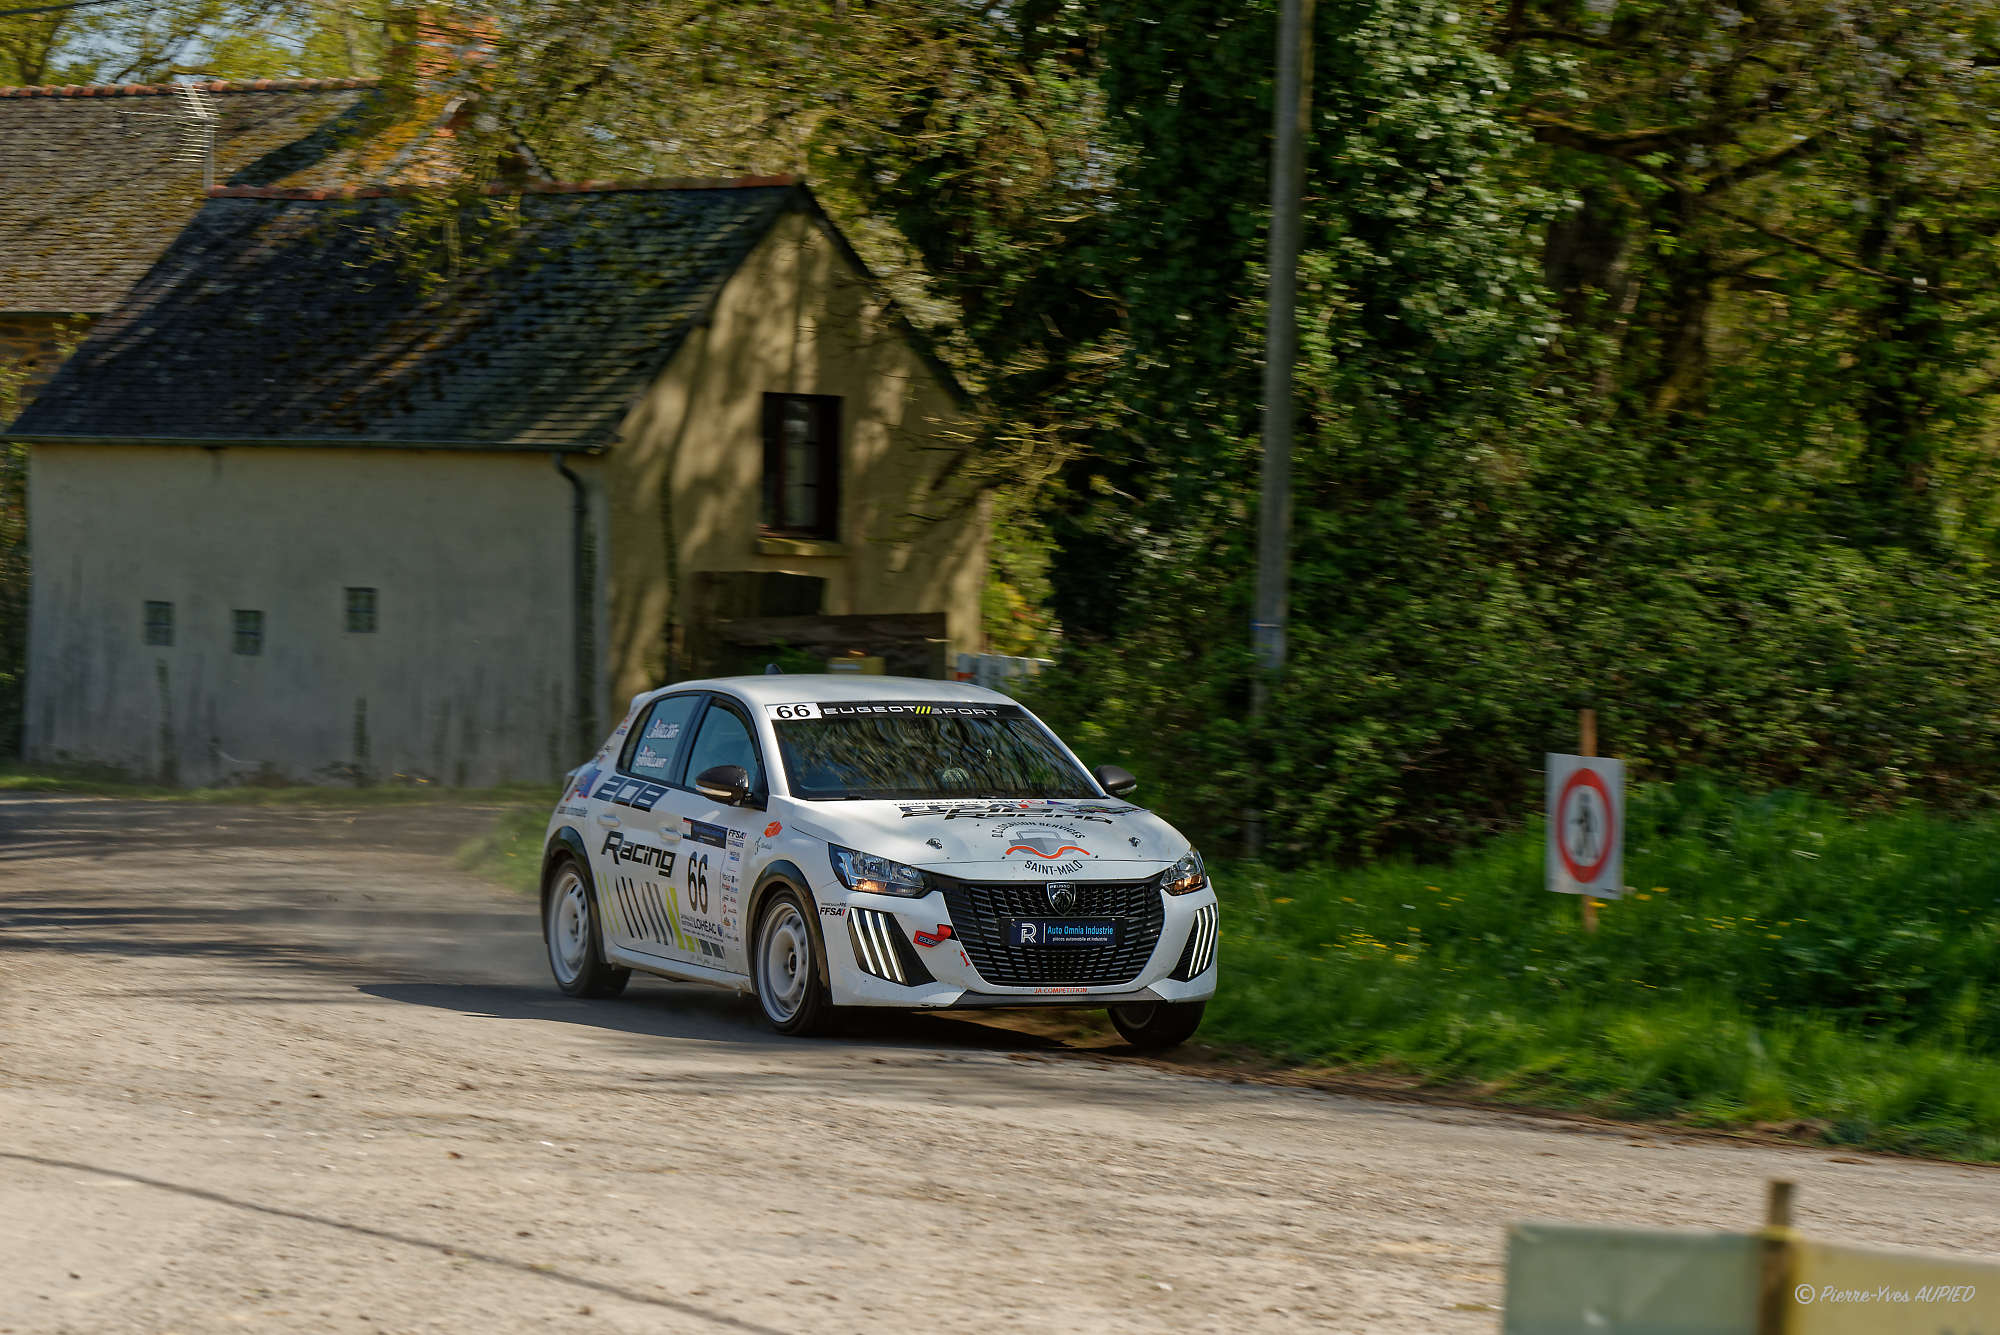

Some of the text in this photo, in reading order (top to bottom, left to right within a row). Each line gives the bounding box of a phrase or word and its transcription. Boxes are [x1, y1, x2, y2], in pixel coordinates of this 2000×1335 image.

[776, 704, 811, 719] 66
[823, 705, 998, 717] EUGEOT SPORT
[601, 830, 676, 878] Racing
[1024, 859, 1084, 876] SAINT-MALO
[688, 851, 708, 915] 66
[819, 906, 845, 917] FFSA
[1047, 925, 1114, 935] Auto Omnia Industrie
